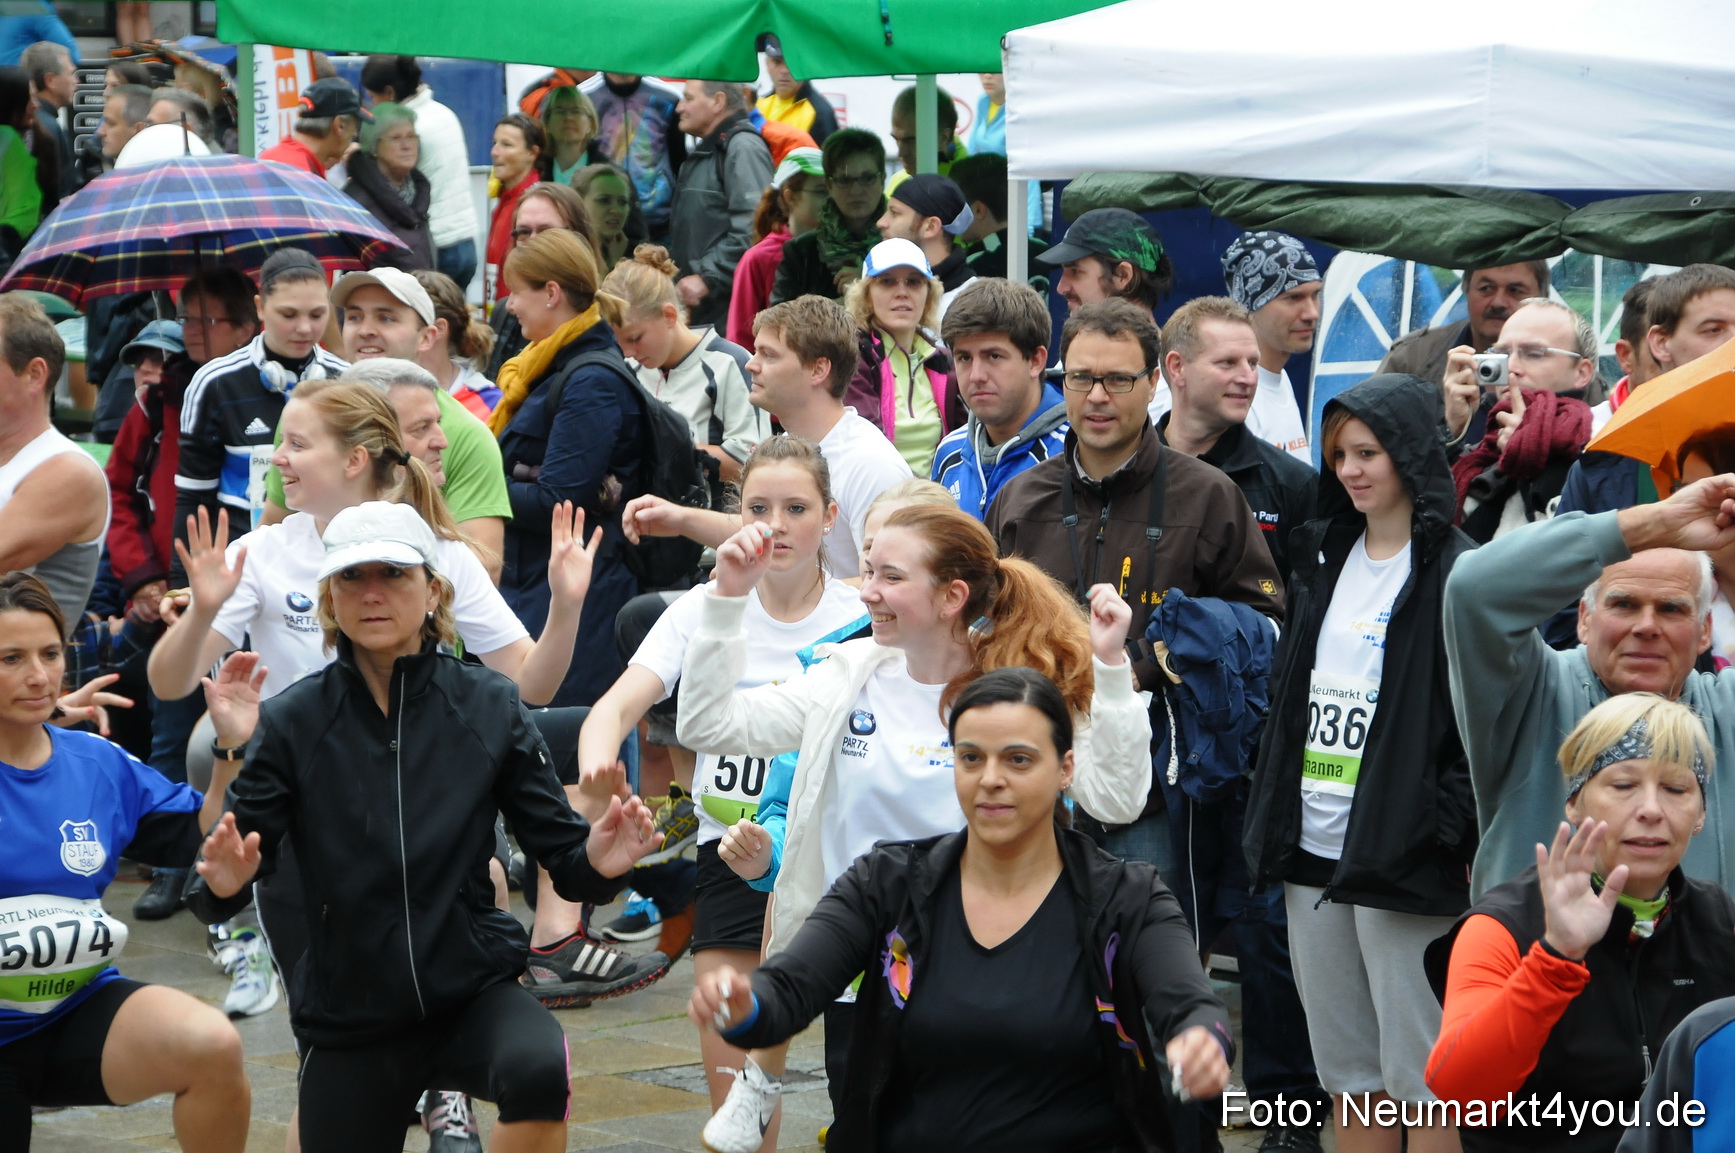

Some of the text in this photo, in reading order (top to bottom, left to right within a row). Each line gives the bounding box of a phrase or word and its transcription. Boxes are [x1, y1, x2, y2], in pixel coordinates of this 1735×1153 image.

[840, 747, 867, 759] Neumarkt
[842, 736, 869, 752] PARTL
[714, 754, 774, 797] 50
[73, 827, 89, 841] SV
[0, 919, 114, 970] 5074
[27, 978, 76, 998] Hilde
